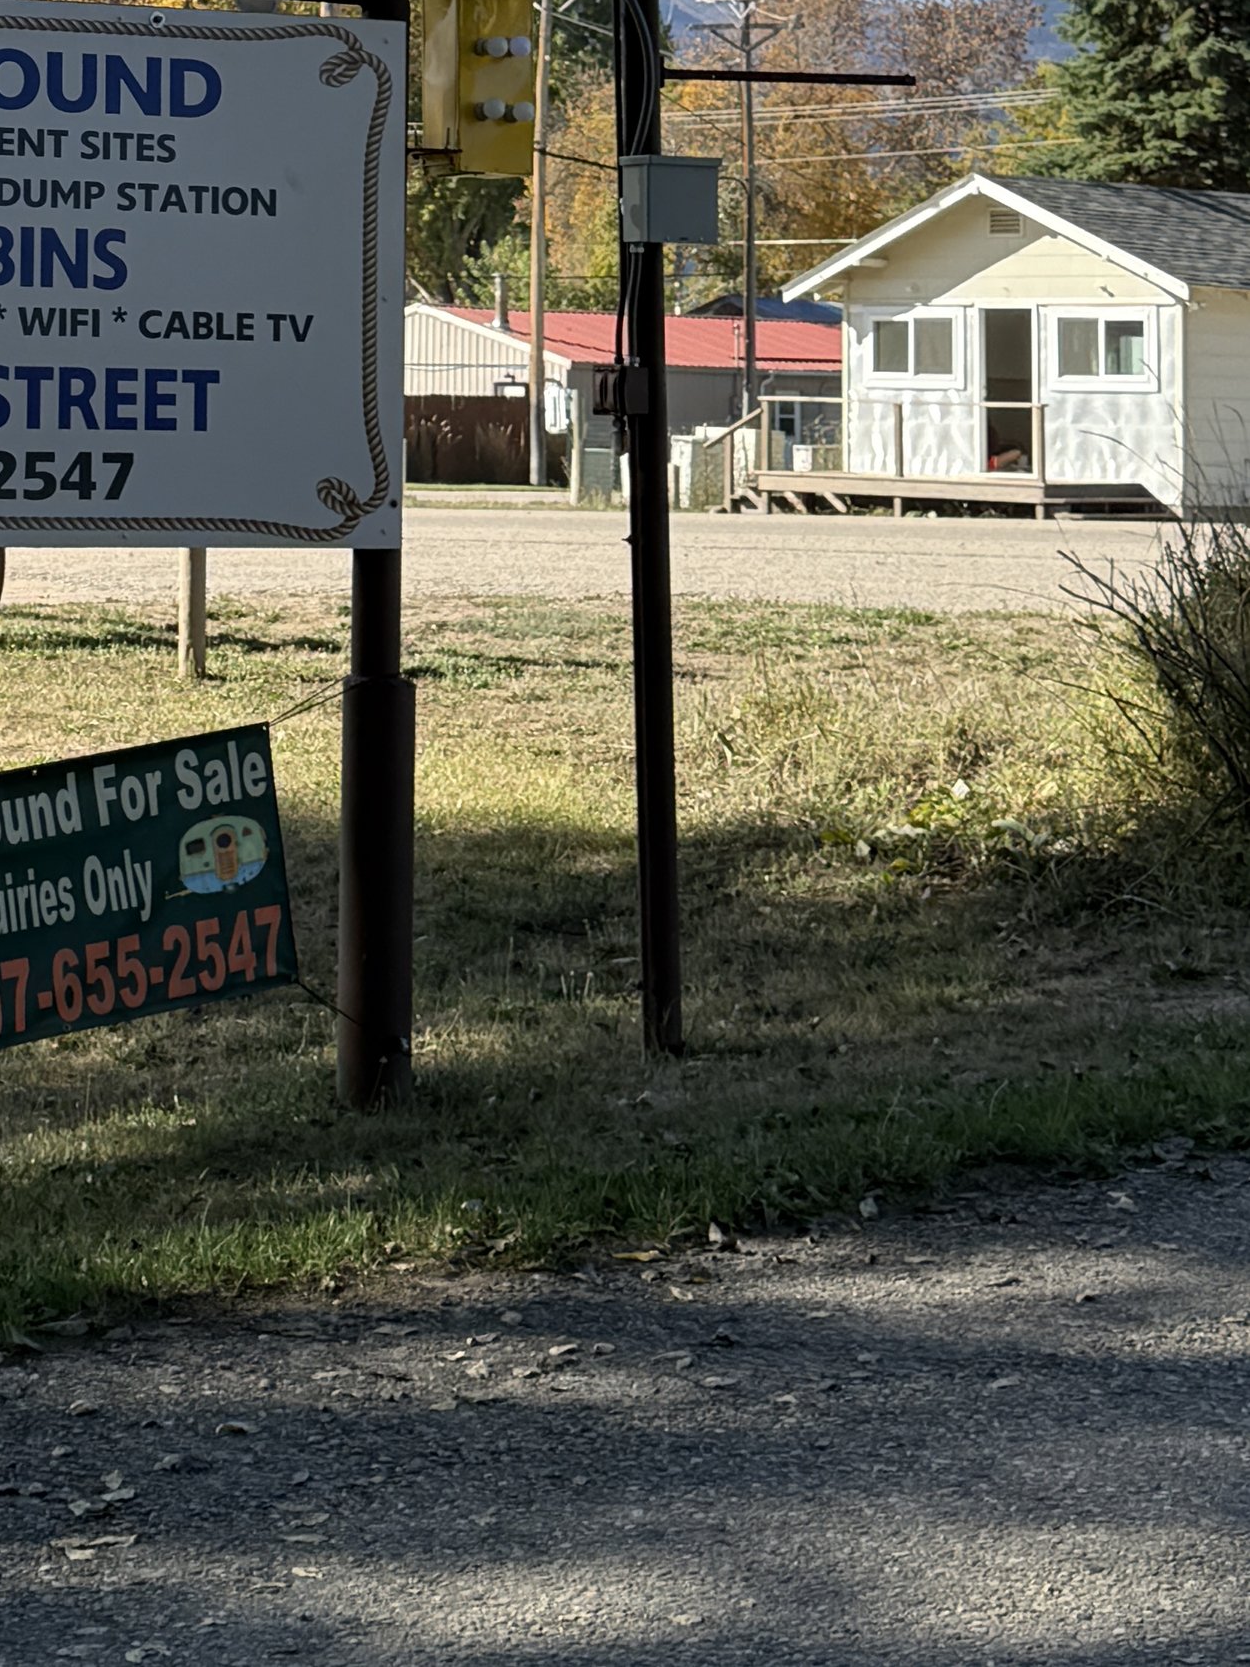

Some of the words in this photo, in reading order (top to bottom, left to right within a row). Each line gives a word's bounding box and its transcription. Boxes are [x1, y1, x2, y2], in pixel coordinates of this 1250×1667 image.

[80, 132, 177, 163] SITES
[116, 182, 277, 217] STATION
[19, 307, 101, 338] WIFI
[138, 310, 255, 343] CABLE
[266, 313, 314, 343] TV
[93, 763, 162, 827] For
[174, 740, 268, 811] Sale
[83, 848, 152, 923] Only
